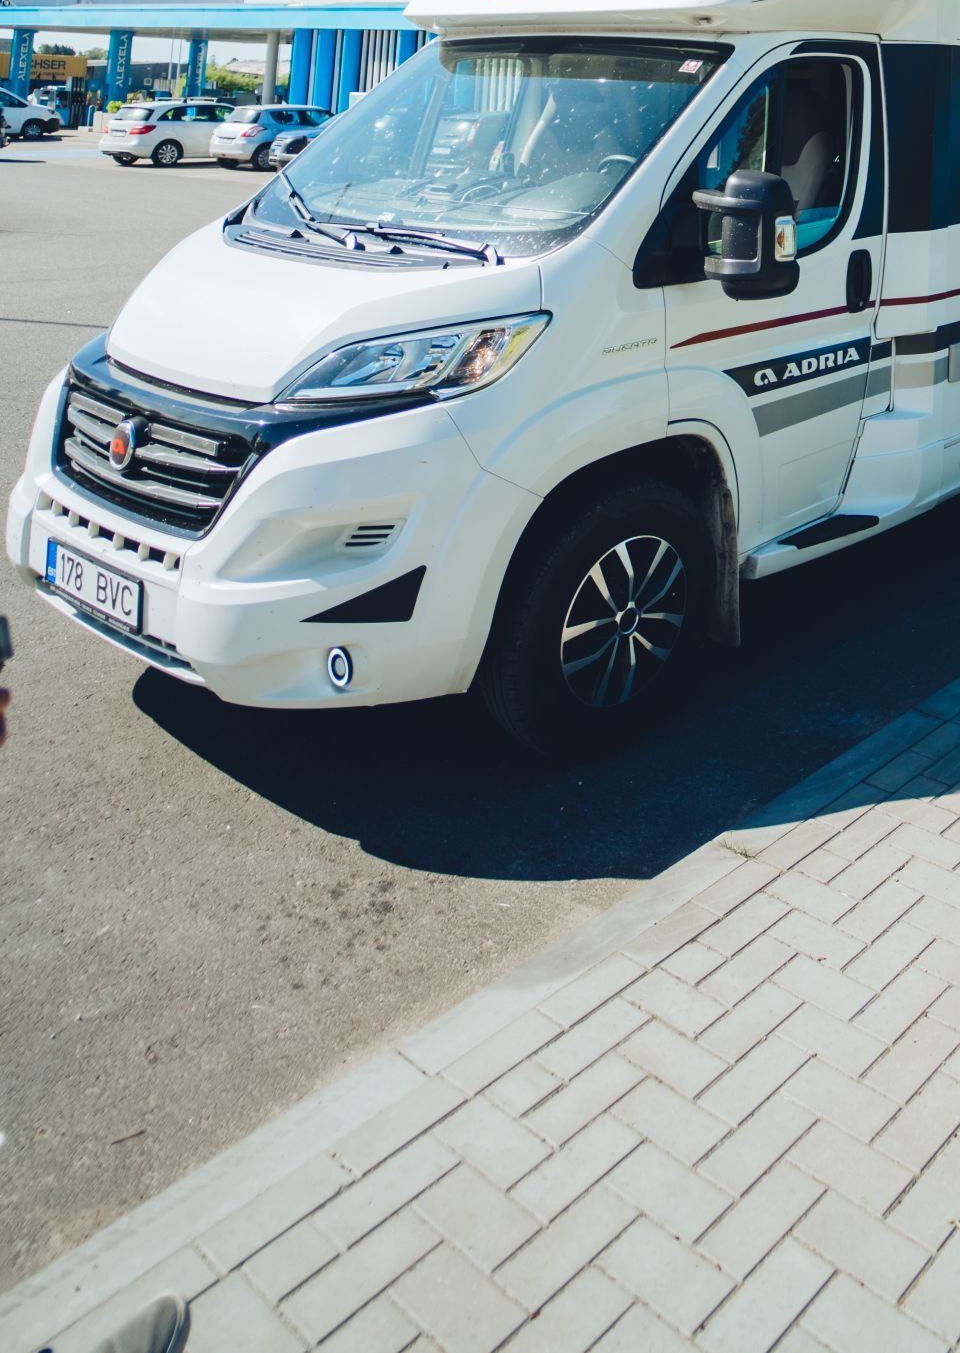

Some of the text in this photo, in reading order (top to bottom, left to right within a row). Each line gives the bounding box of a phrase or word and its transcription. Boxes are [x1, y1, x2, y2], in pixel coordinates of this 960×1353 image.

[18, 32, 31, 81] ALEXELA
[115, 34, 129, 87] ALEXELA
[782, 347, 860, 380] ADRIA
[61, 553, 84, 591] 178
[96, 571, 133, 616] BVC
